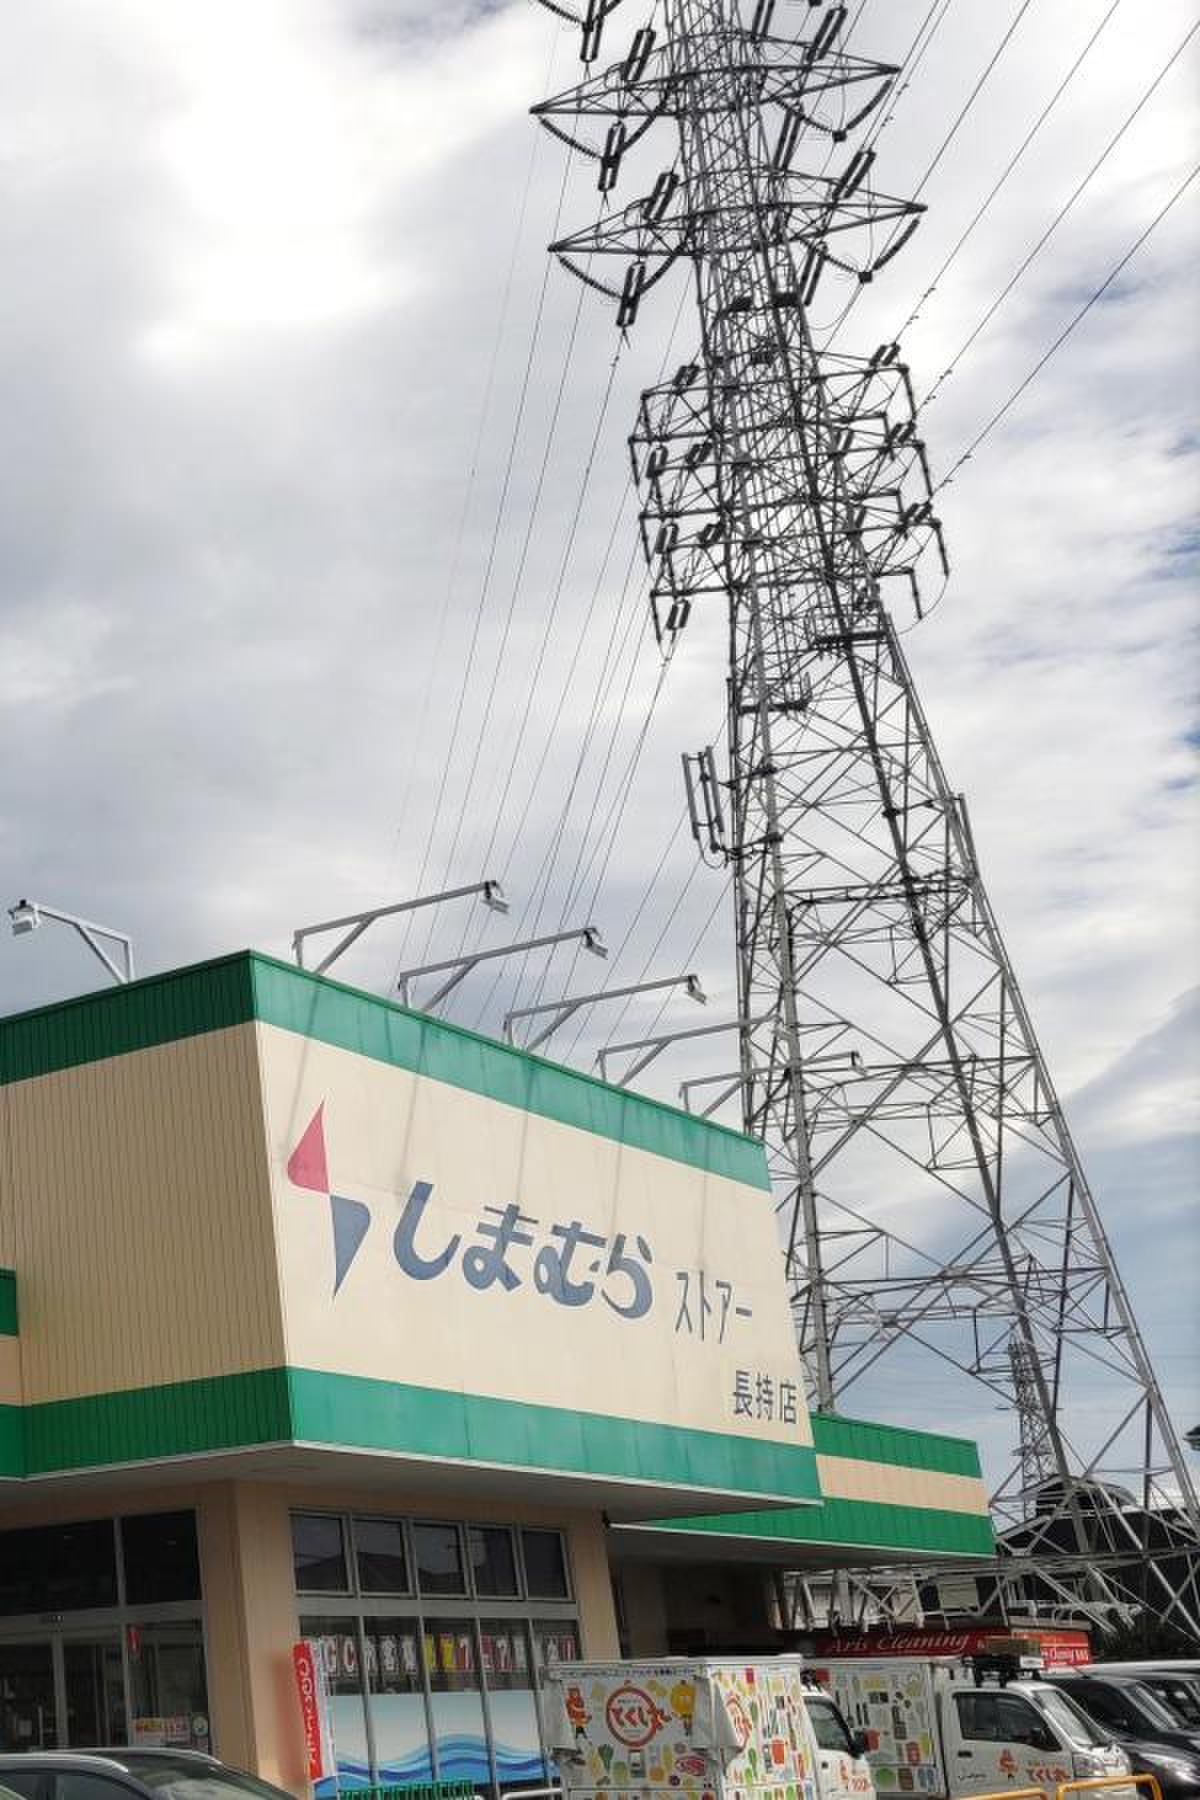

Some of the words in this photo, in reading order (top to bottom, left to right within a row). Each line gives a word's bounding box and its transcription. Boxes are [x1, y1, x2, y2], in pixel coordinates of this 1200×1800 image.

[393, 1181, 653, 1318] しまむら
[675, 1270, 753, 1344] ストアー
[733, 1369, 797, 1424] 長持店
[878, 1632, 969, 1650] Cleaning
